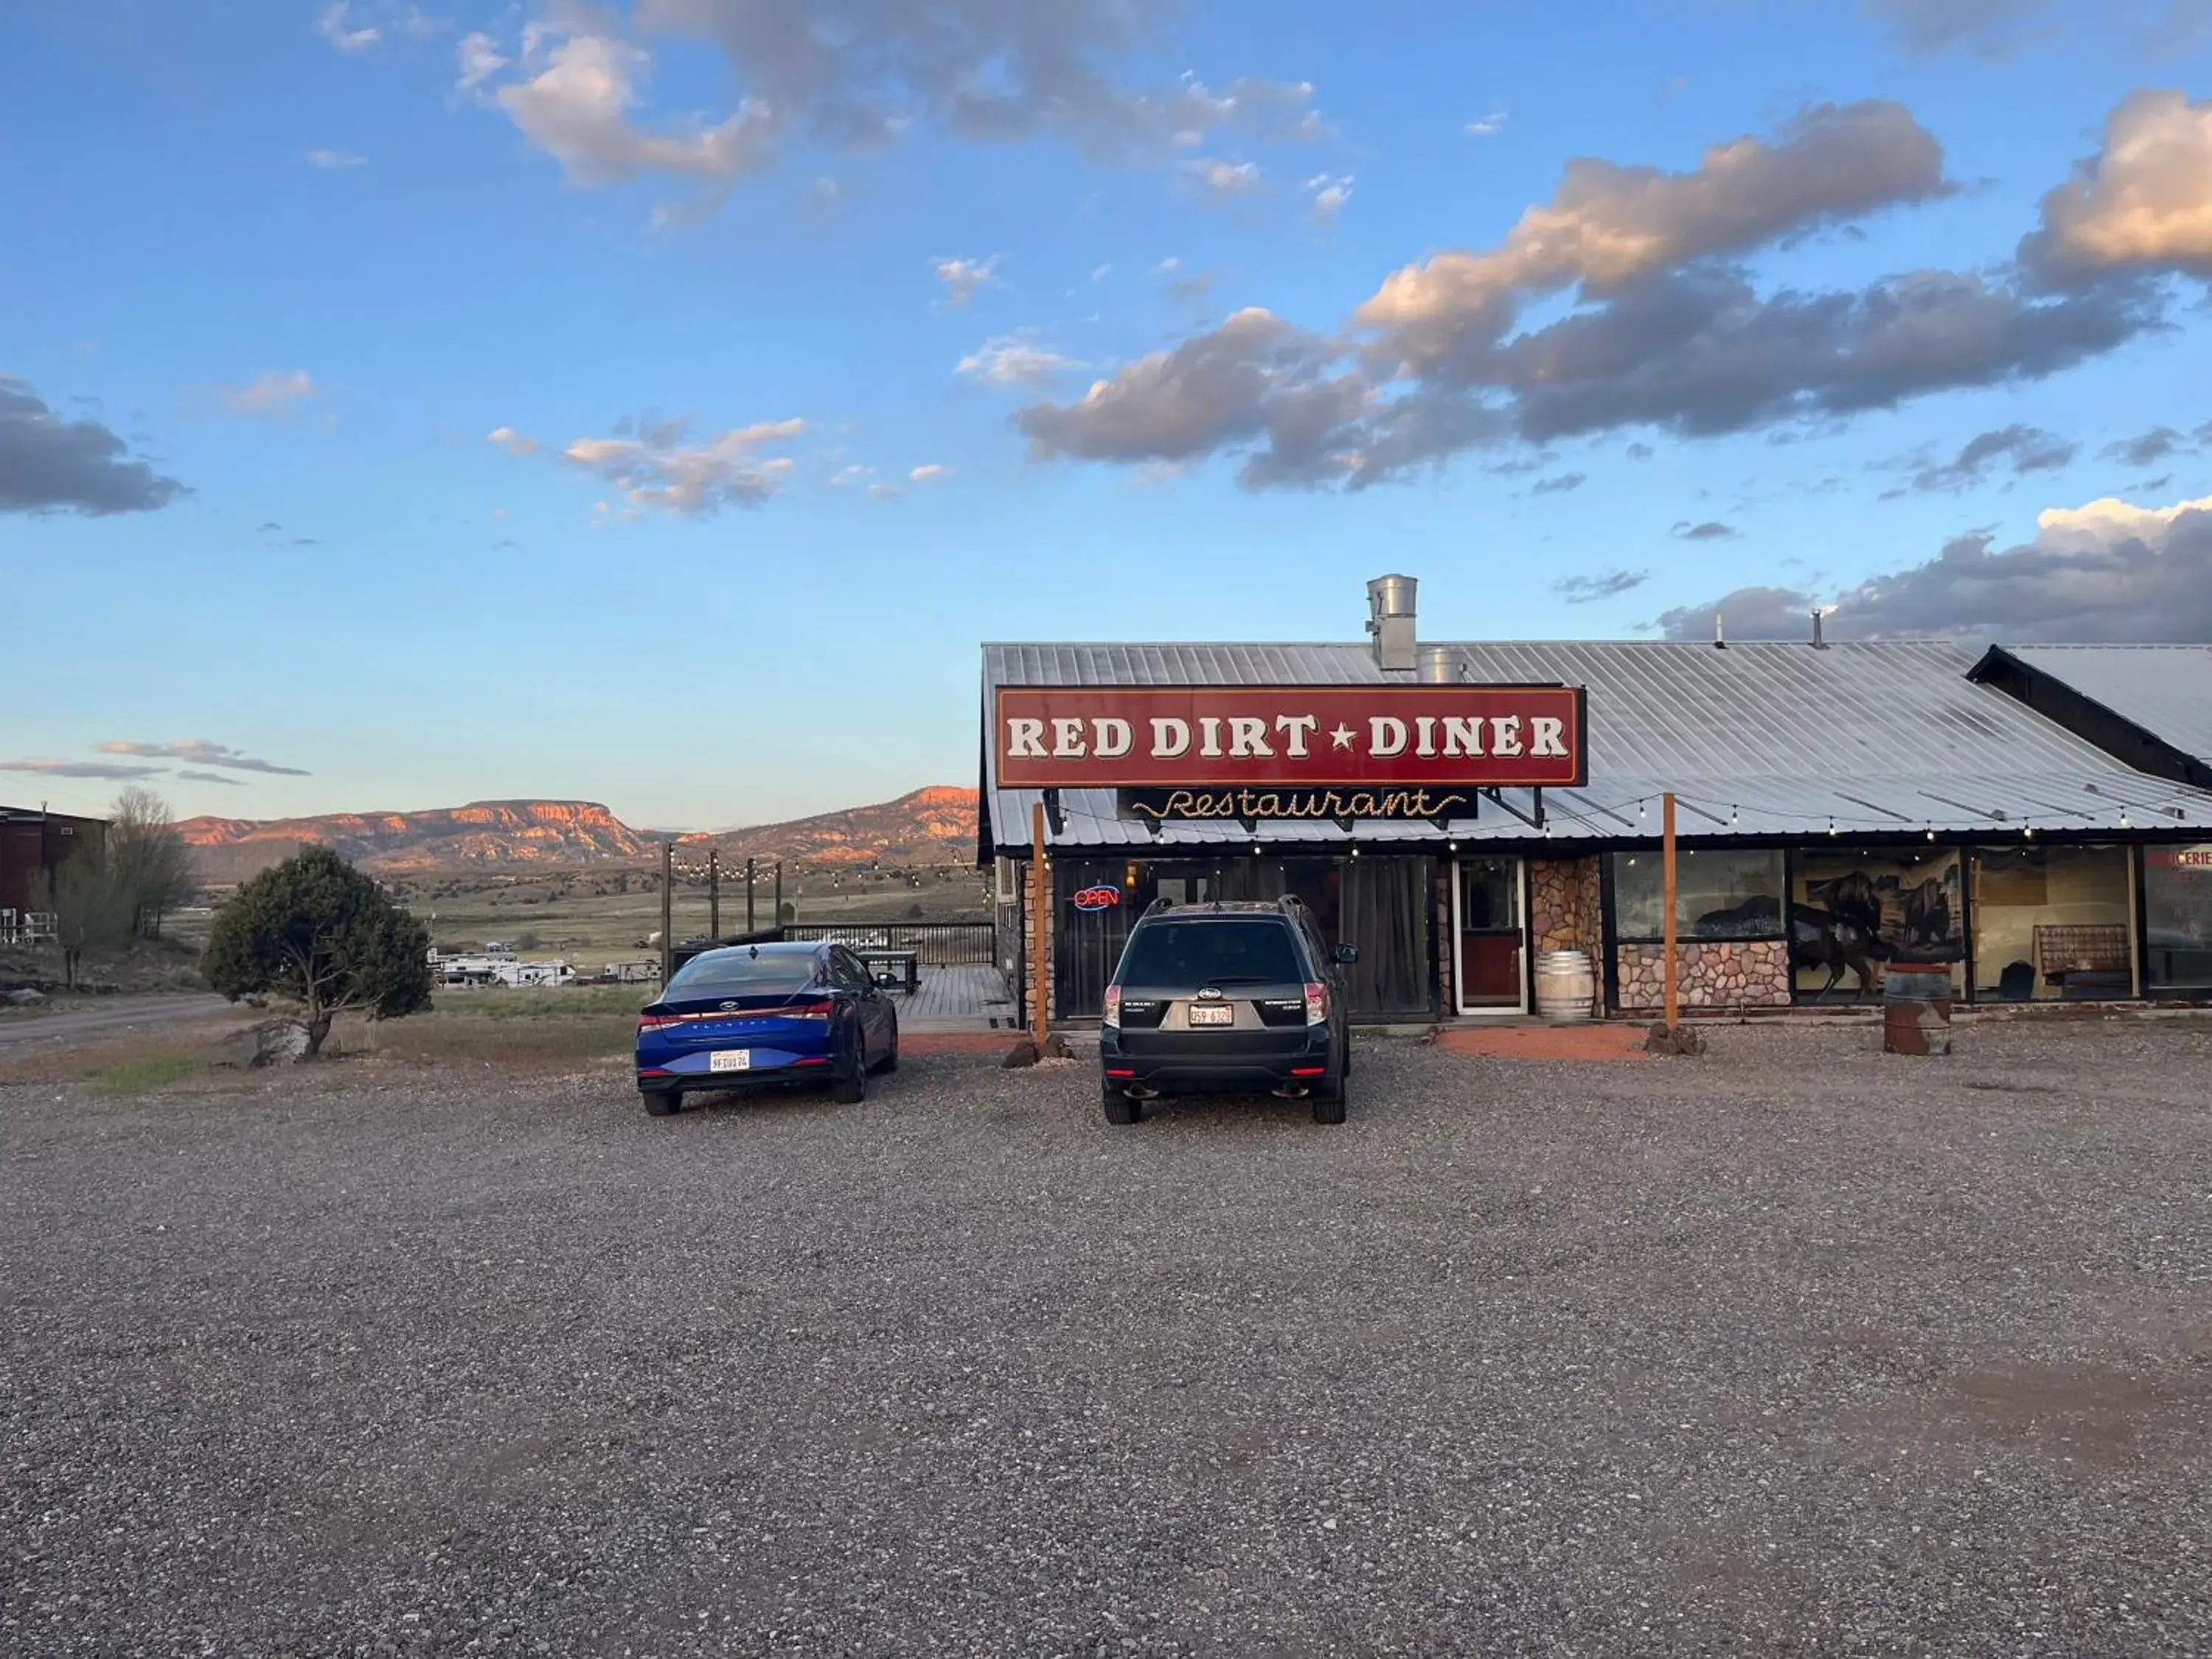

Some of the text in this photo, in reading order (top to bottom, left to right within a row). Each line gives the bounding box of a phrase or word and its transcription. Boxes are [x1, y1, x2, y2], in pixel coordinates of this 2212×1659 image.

[1007, 714, 1569, 758] RED DIRT DINER
[1133, 788, 1467, 818] Restaurant
[1075, 890, 1119, 905] OPEN
